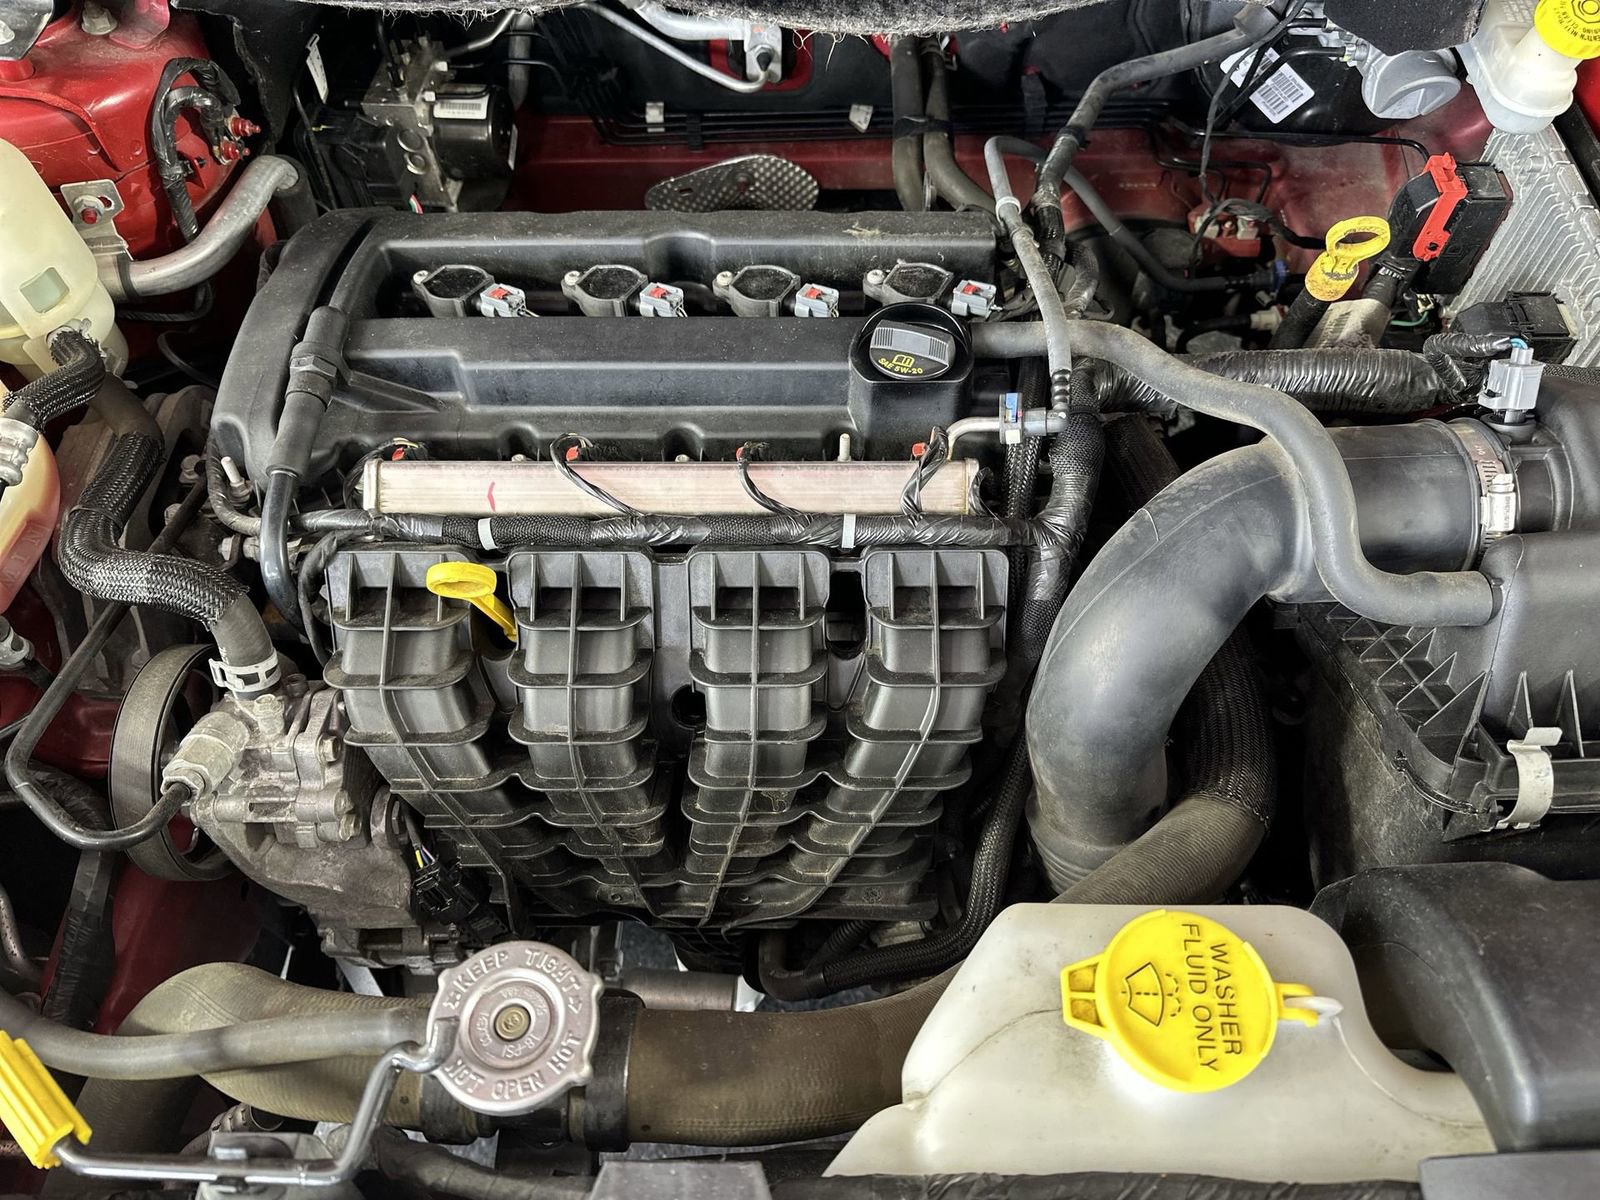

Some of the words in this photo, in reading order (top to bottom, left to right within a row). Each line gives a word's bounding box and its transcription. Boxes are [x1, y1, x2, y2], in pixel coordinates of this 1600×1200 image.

[878, 357, 893, 369] SAE
[894, 365, 924, 375] 5W-20
[453, 950, 509, 993] KEEP
[525, 948, 582, 993] TIGHT
[1181, 922, 1208, 996] FLUID
[1210, 942, 1243, 1055] WASHER
[491, 1069, 545, 1100] OPEN
[547, 1030, 582, 1076] HOT
[1192, 1005, 1219, 1072] ONLY
